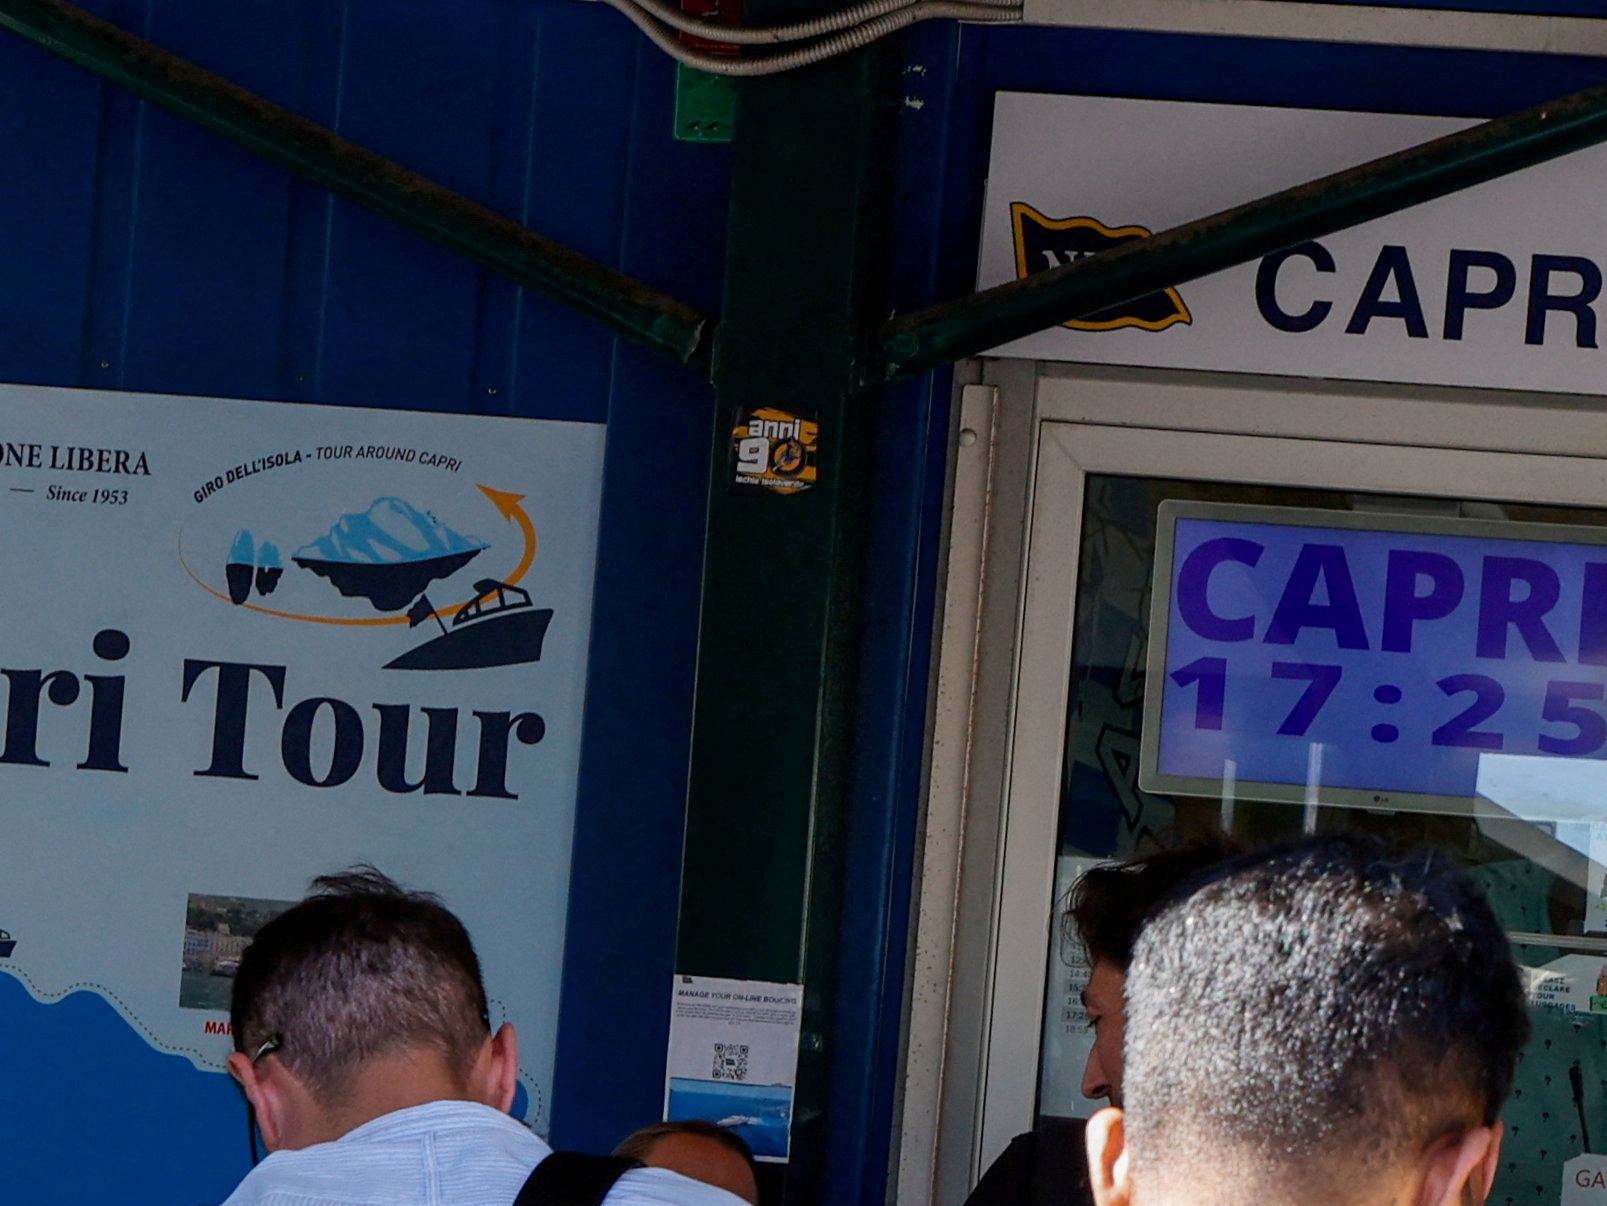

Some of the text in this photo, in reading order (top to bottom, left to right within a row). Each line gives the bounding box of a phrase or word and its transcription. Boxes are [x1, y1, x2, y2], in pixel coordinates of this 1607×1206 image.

[749, 418, 801, 440] anni
[0, 442, 152, 477] NE LIBERA
[193, 476, 224, 504] GIRO
[316, 446, 354, 460] TOUR
[356, 446, 416, 463] AROUND
[418, 451, 463, 473] CAPRI
[46, 485, 129, 505] Since 1953
[0, 629, 546, 800] ri Tour
[678, 989, 709, 999] MANAGE
[711, 991, 731, 1000] YOUR
[1537, 985, 1570, 993] ECLARE
